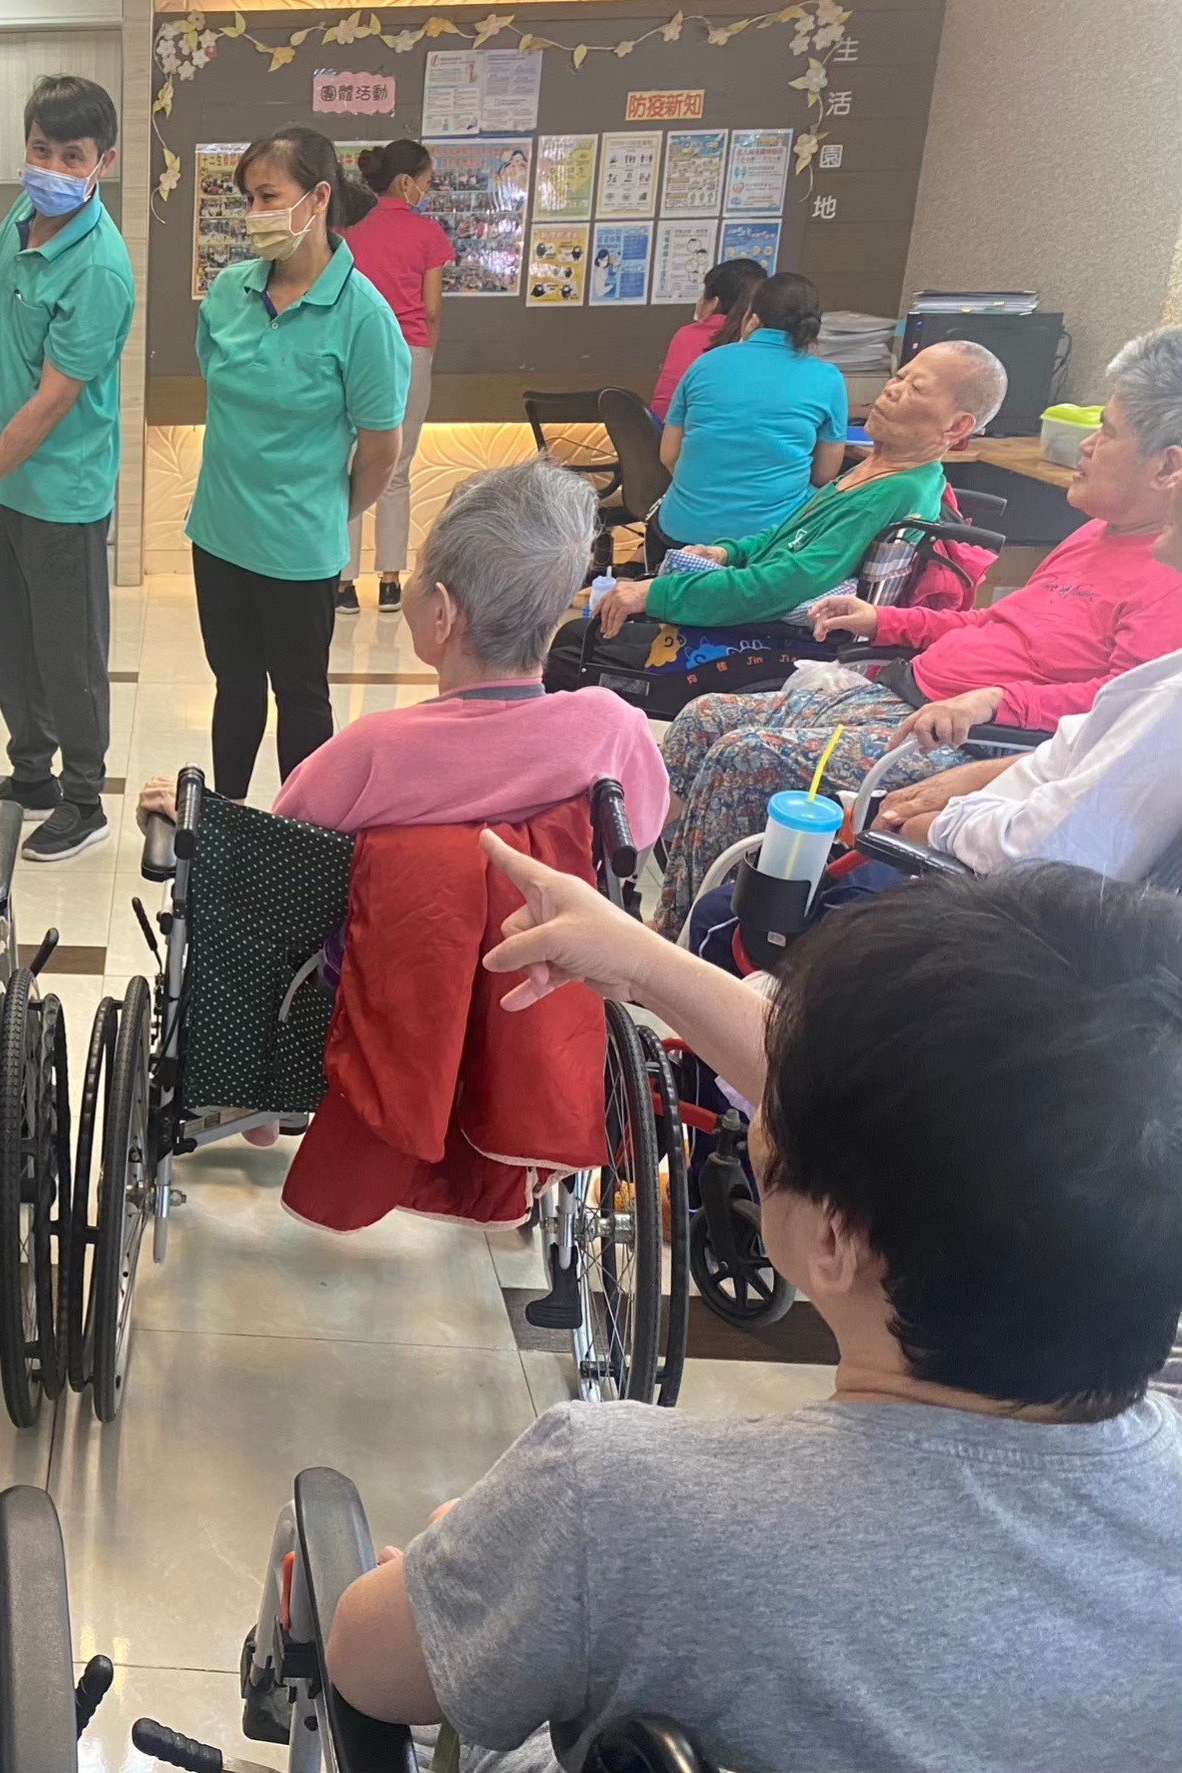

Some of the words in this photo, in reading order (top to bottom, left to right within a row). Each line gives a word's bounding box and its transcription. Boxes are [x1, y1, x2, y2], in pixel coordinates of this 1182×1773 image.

[321, 84, 388, 101] 團體活動
[628, 93, 702, 118] 防疫新知
[812, 37, 859, 219] 生活園地
[747, 656, 763, 665] Jin
